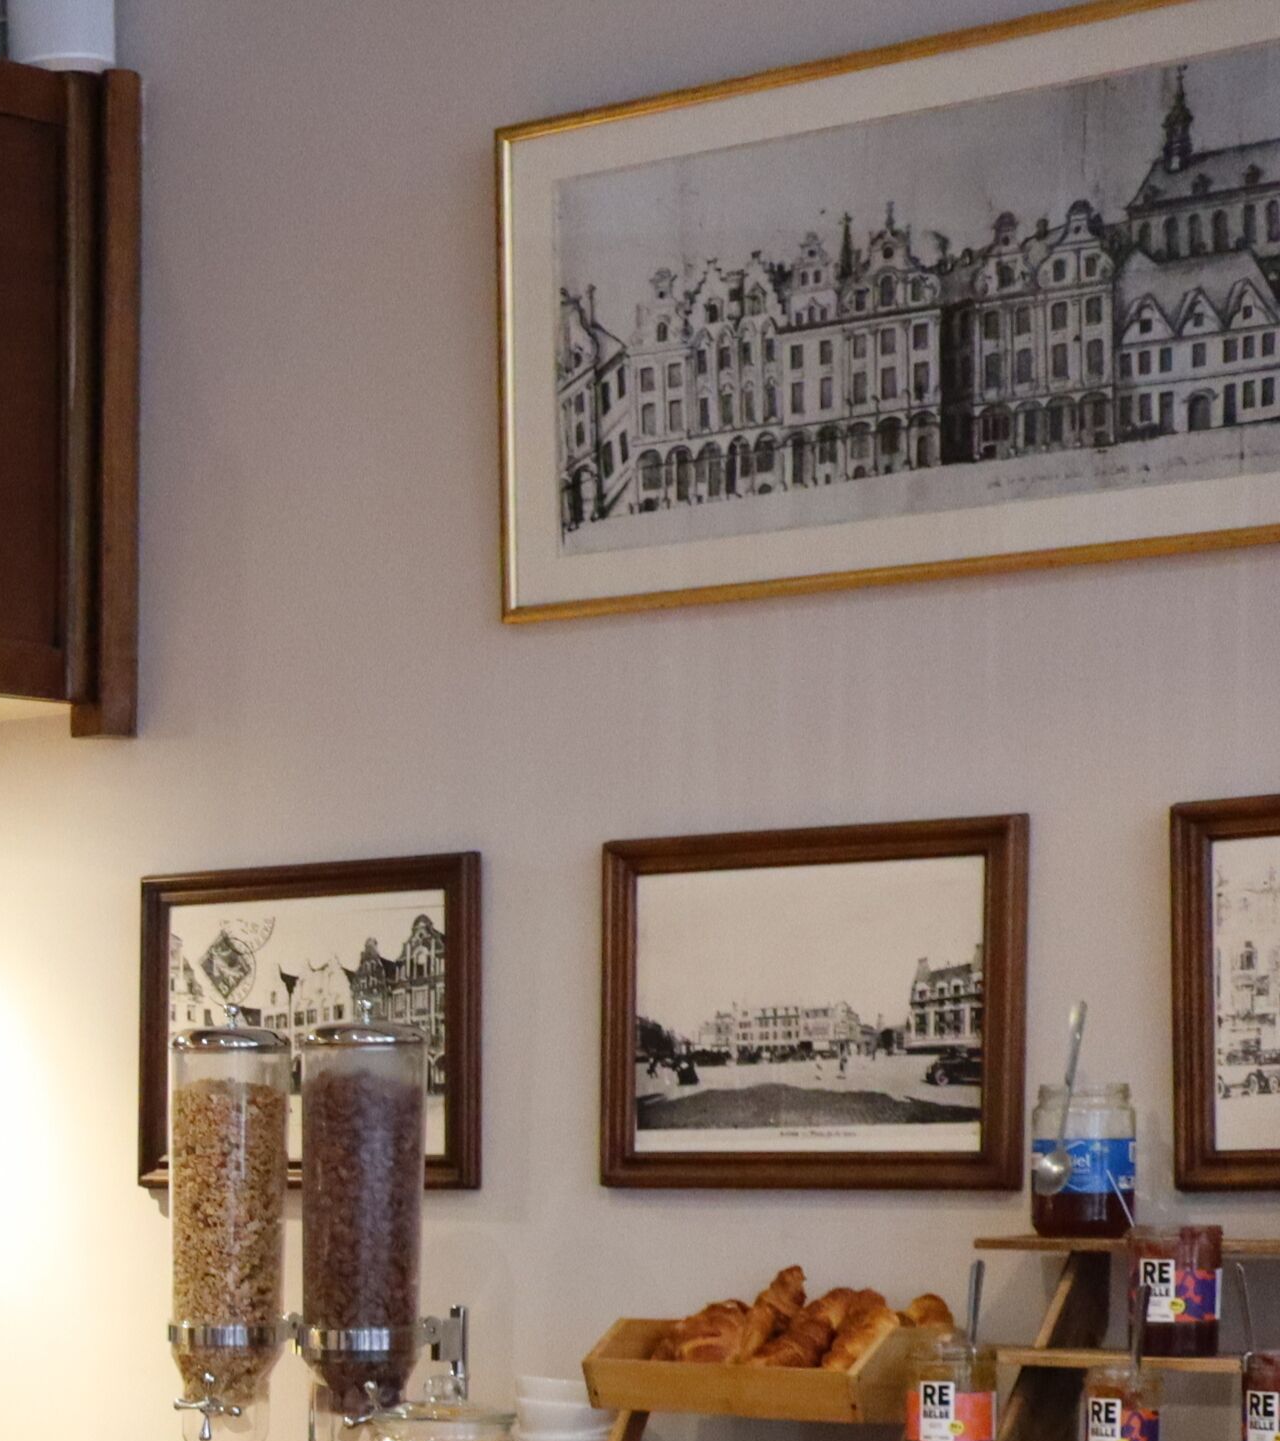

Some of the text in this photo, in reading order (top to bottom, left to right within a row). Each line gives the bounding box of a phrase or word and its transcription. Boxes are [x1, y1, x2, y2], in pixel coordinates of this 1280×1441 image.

[1143, 1262, 1170, 1284] RE
[923, 1384, 950, 1406] RE
[1249, 1393, 1274, 1417] RE
[1091, 1401, 1116, 1424] RE
